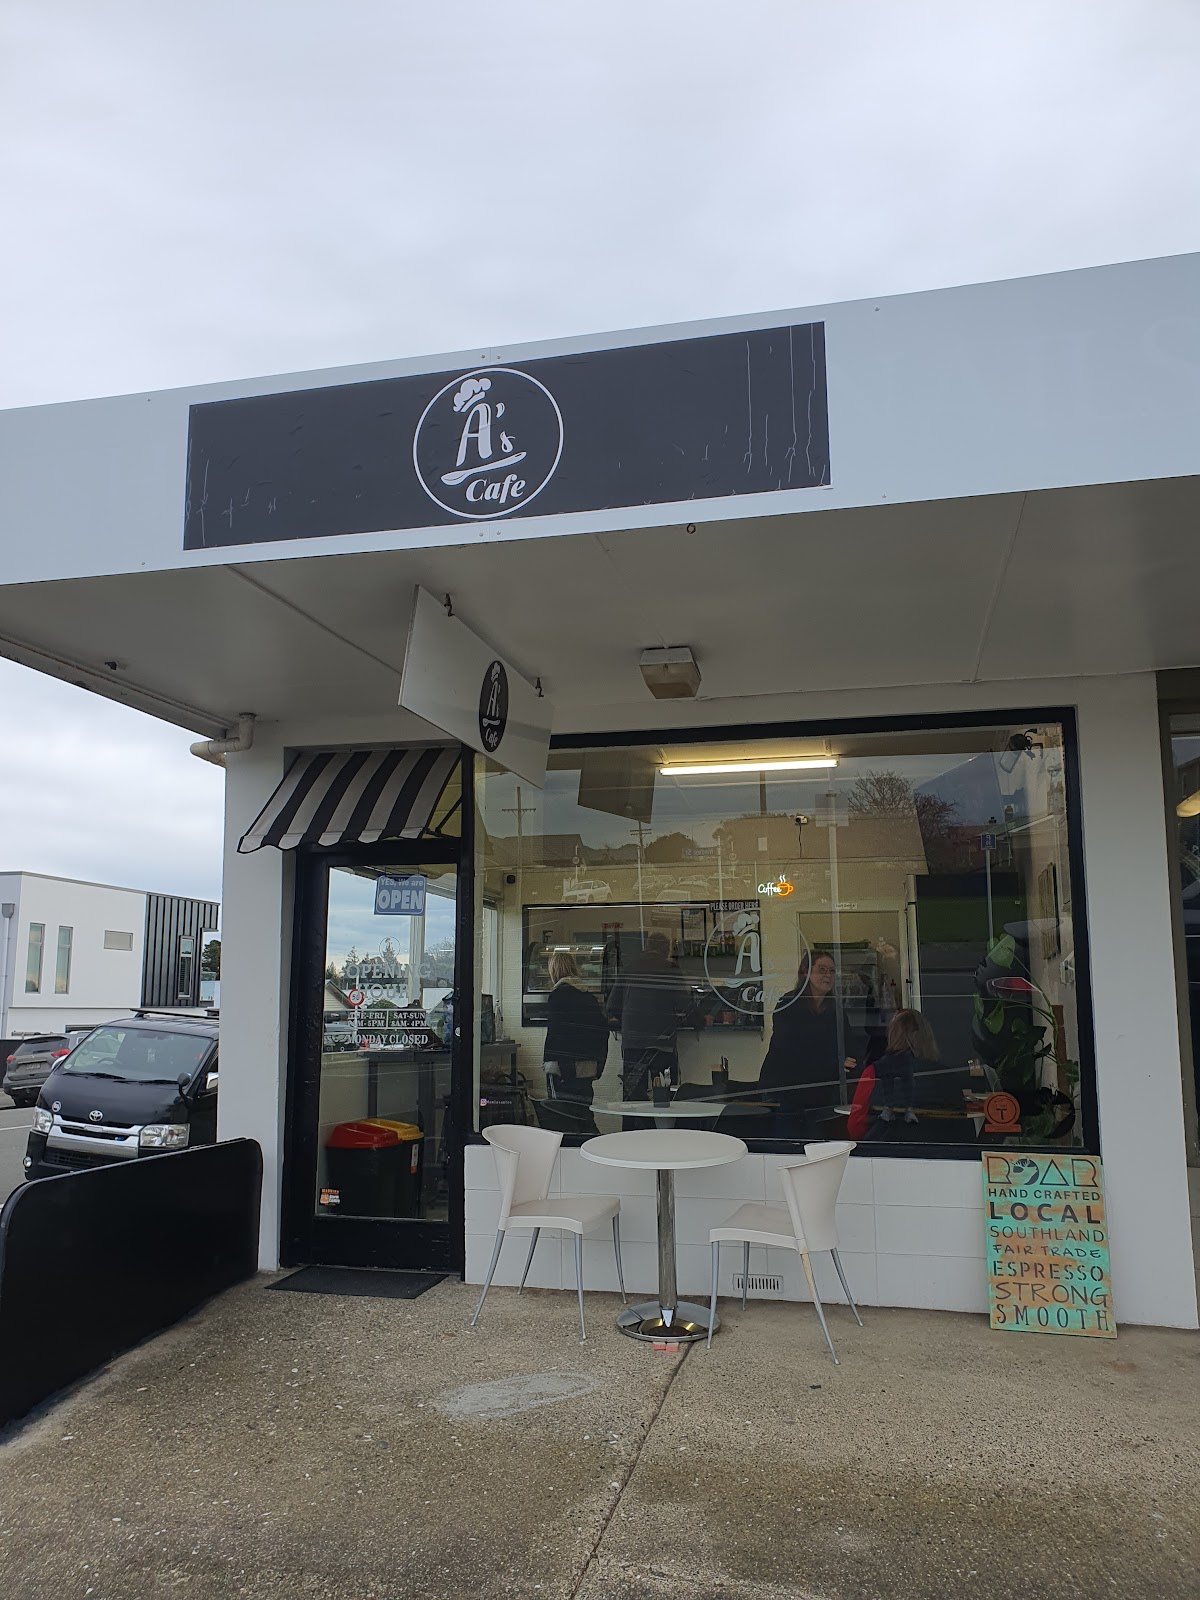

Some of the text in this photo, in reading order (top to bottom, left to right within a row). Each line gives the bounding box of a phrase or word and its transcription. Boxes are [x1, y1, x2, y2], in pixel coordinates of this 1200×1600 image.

[456, 402, 516, 467] A's
[465, 473, 526, 504] Cafe
[485, 728, 499, 748] Cafe
[757, 882, 782, 896] Coffee
[378, 889, 424, 910] OPEN
[710, 902, 728, 911] PLEASE
[346, 963, 431, 979] OPENING
[358, 984, 421, 999] HOUR
[349, 1034, 429, 1045] MONDAY CLOSED
[988, 1188, 1101, 1201] HAND CRAFTED
[989, 1201, 1101, 1224] LOCAL
[990, 1225, 1105, 1242] SOUTHLAND
[993, 1244, 1101, 1259] FAIR TRADE
[993, 1260, 1104, 1282] ESPRESSO
[995, 1281, 1108, 1308] STRONG
[996, 1304, 1110, 1331] SMOOTH
